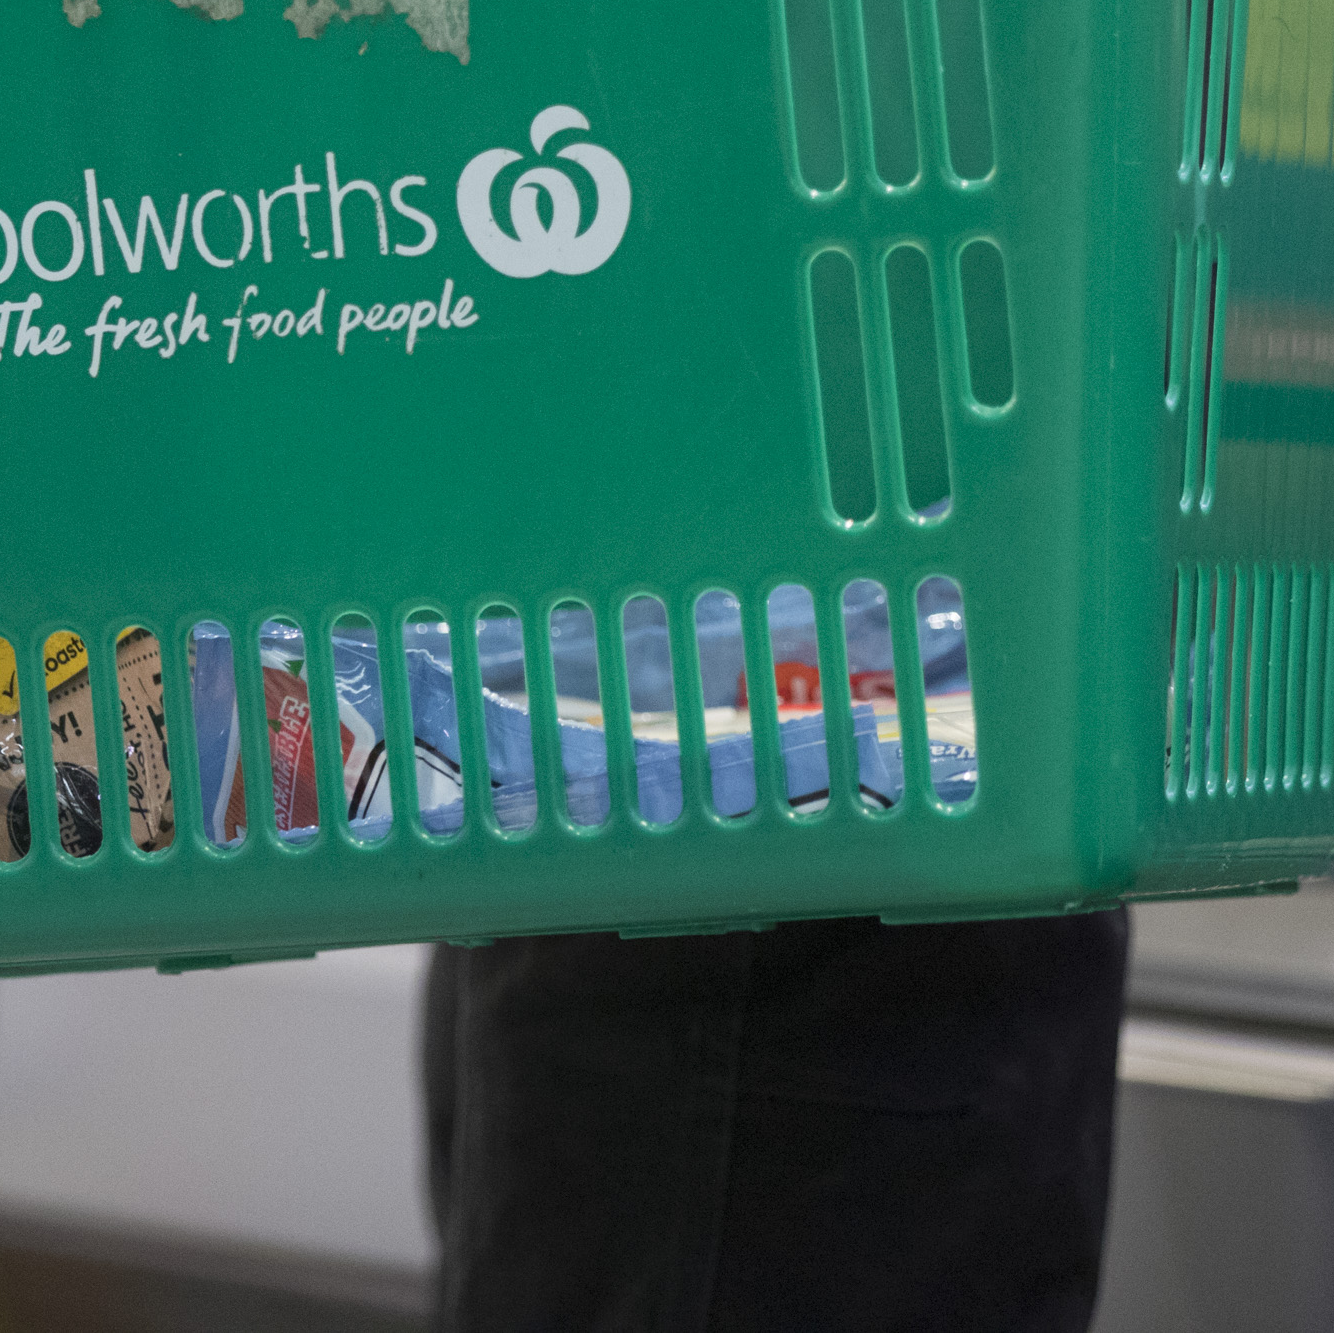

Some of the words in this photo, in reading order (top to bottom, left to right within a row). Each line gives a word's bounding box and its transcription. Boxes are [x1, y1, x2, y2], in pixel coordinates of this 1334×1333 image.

[85, 293, 210, 377] fresh
[223, 286, 326, 364] food
[338, 279, 479, 355] people
